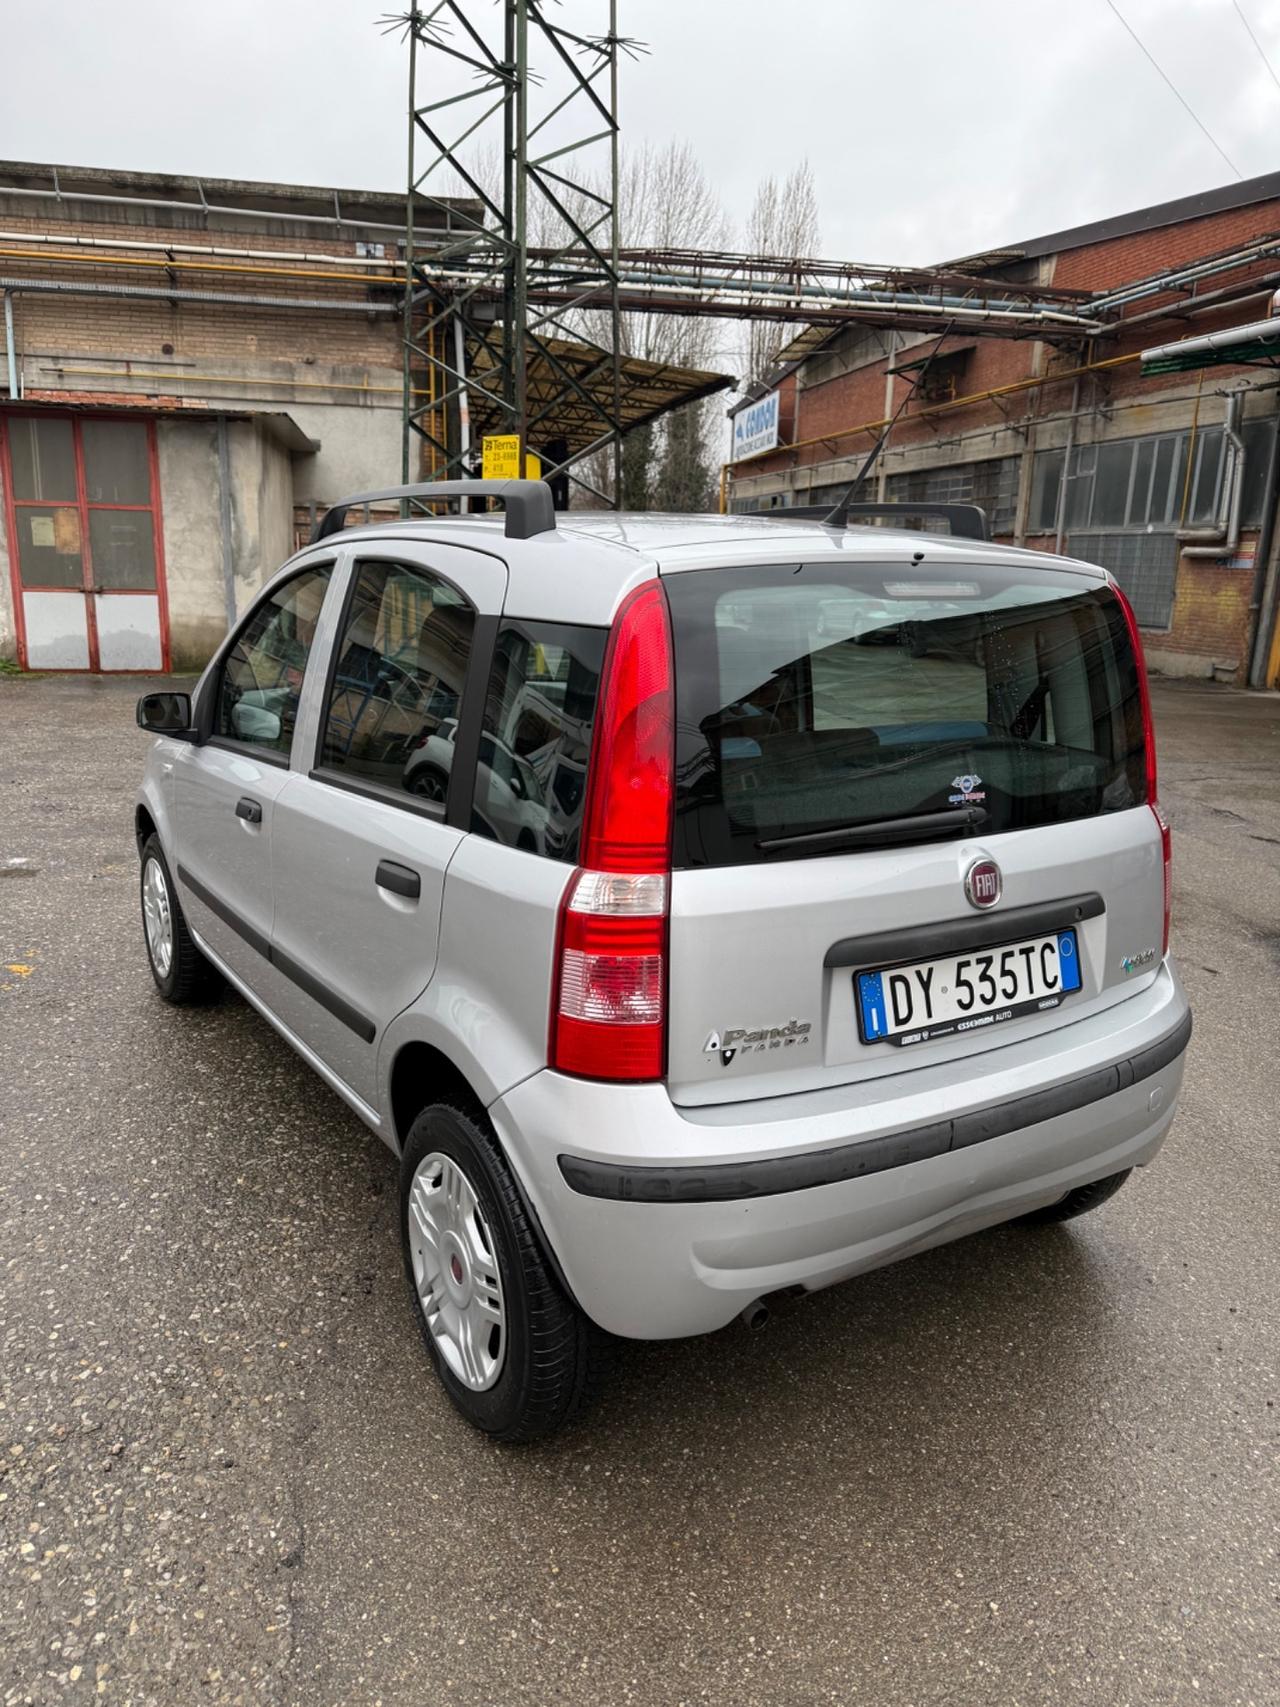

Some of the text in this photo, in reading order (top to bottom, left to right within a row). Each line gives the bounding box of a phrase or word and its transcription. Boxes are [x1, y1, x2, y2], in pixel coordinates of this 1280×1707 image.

[493, 439, 517, 451] Terna
[975, 872, 997, 897] FIAT
[889, 942, 1059, 1027] DY 535TC
[995, 1010, 1012, 1022] AUTO
[722, 1018, 812, 1047] Panda
